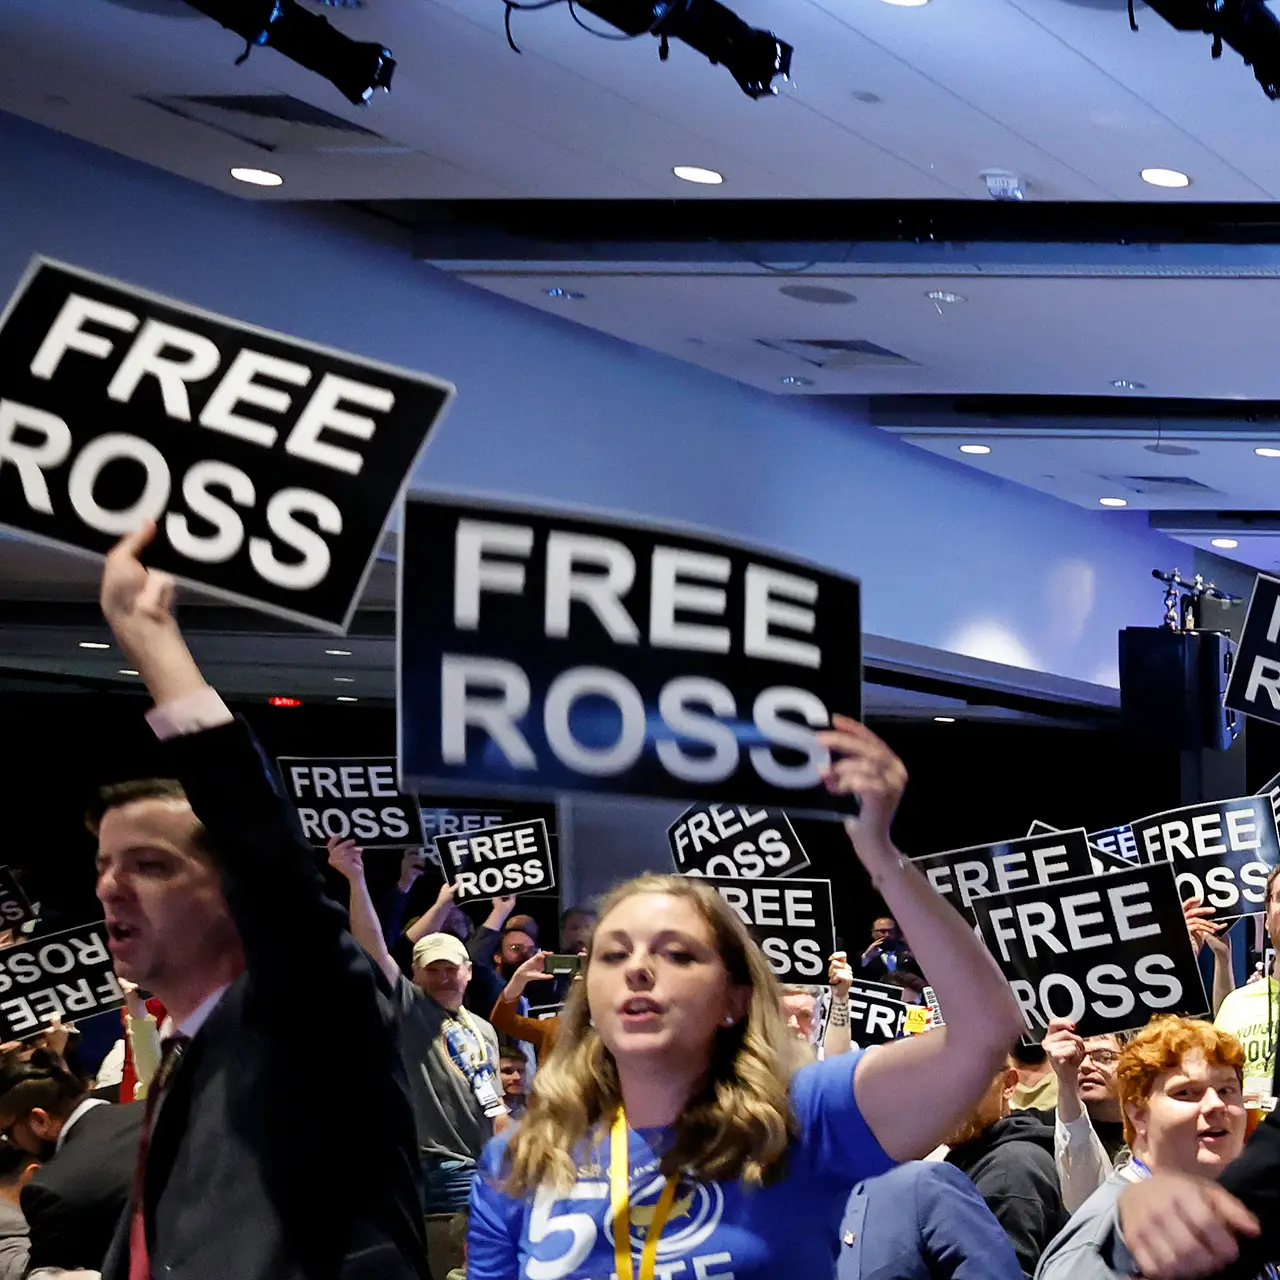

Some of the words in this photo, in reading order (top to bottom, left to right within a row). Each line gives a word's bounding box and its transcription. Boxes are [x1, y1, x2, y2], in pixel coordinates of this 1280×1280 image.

[30, 293, 395, 475] FREE
[0, 401, 343, 590] ROSS
[453, 518, 822, 669] FREE
[440, 652, 831, 790] ROSS
[290, 766, 398, 798] FREE
[297, 807, 410, 839] ROSS
[448, 827, 538, 867] FREE
[1097, 831, 1139, 859] EE
[1142, 809, 1262, 864] FREE
[684, 828, 791, 878] OSS
[455, 859, 544, 898] ROSS
[1175, 861, 1270, 908] OSS
[718, 886, 816, 927] REE
[988, 881, 1161, 962] FREE
[761, 937, 823, 976] SS
[1, 971, 124, 1032] FREE
[1009, 954, 1183, 1030] ROSS
